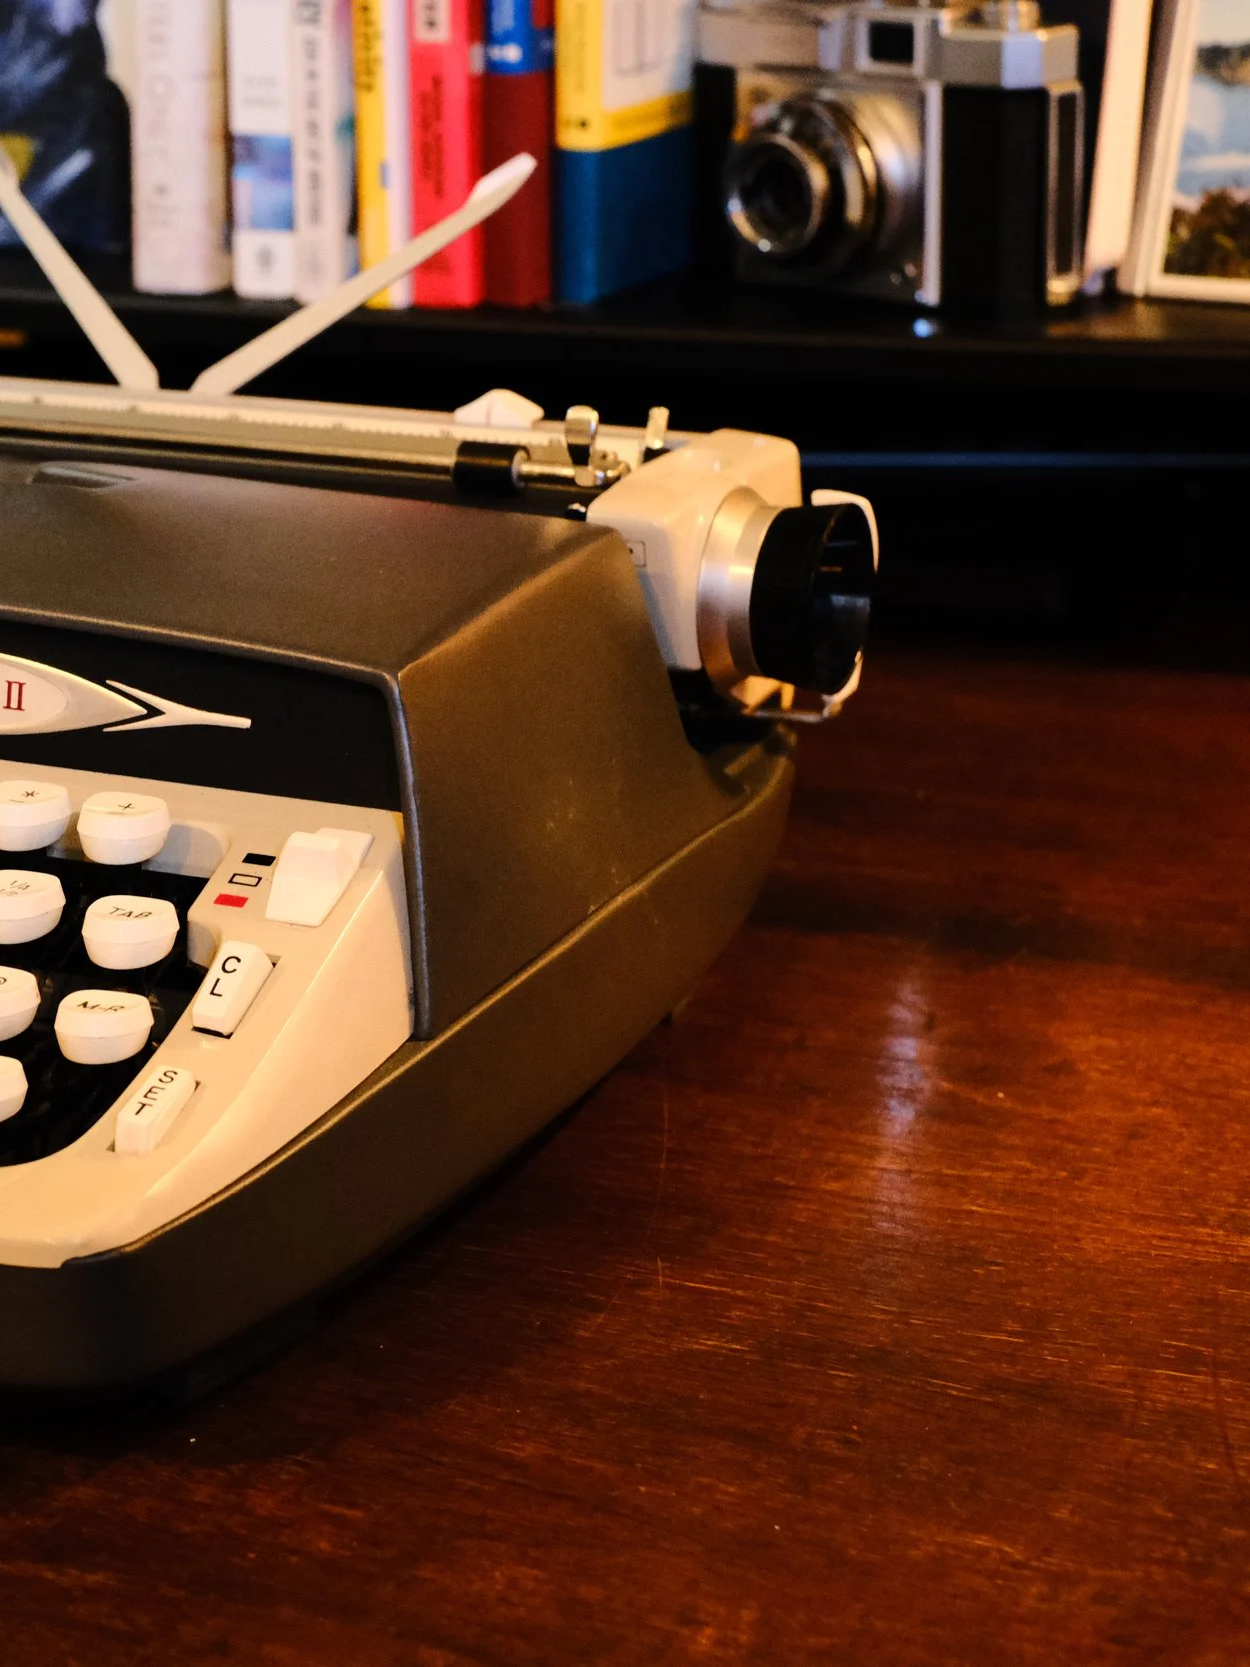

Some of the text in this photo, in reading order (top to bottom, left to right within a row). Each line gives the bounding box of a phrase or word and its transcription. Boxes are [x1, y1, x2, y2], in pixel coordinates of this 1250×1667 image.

[3, 680, 27, 712] II
[109, 906, 153, 919] TAB
[76, 1000, 126, 1013] M-R
[134, 1069, 179, 1117] SET
